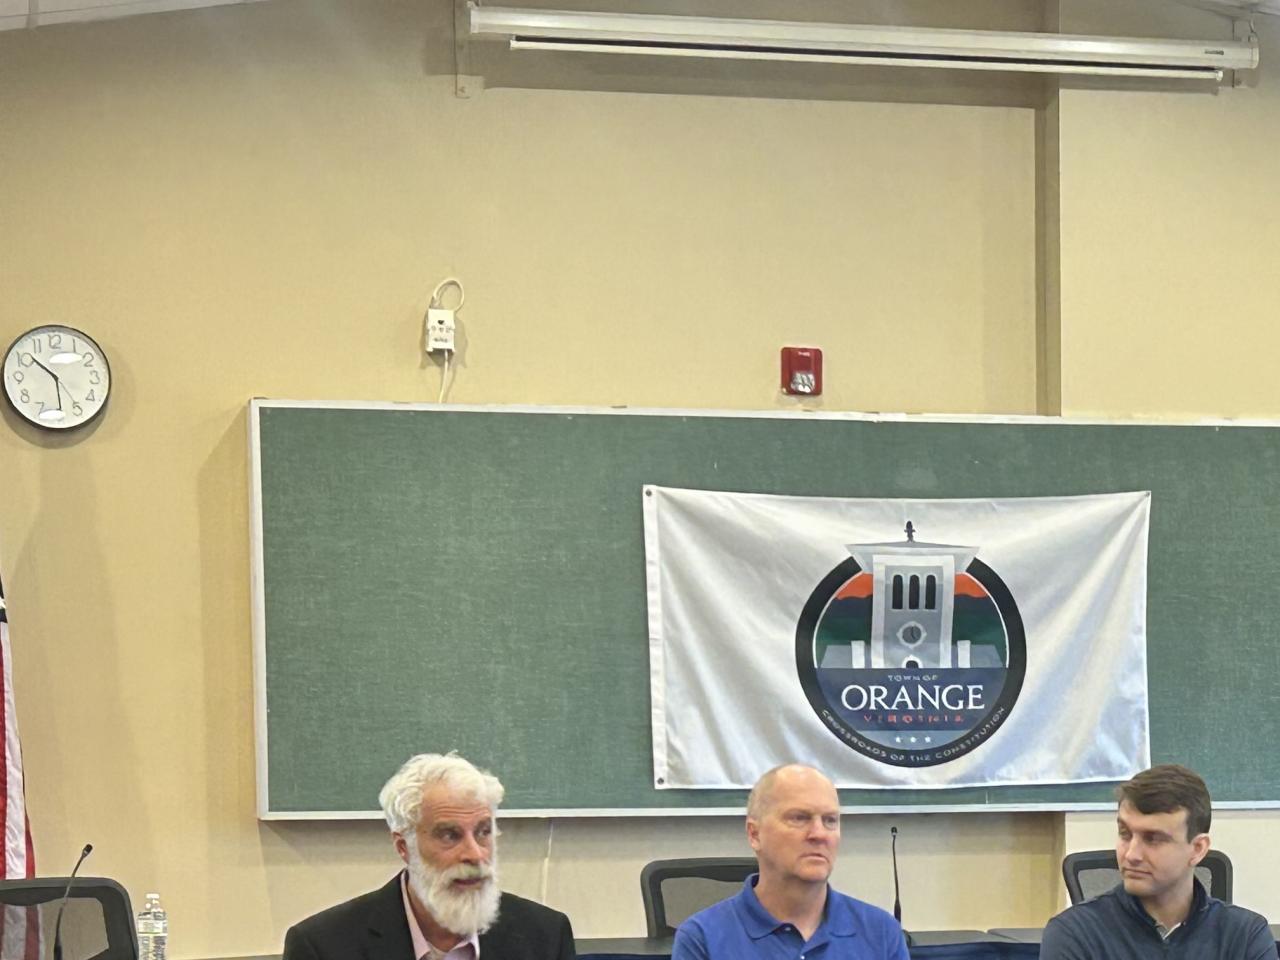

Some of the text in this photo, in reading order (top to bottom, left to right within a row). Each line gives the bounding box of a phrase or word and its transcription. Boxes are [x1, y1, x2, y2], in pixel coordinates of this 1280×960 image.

[33, 339, 42, 354] 11
[48, 334, 61, 349] 12
[72, 338, 76, 353] 1
[16, 350, 35, 368] 10
[82, 352, 94, 367] 2
[13, 371, 24, 384] 9
[89, 370, 100, 384] 3
[20, 389, 30, 403] 8
[85, 388, 96, 402] 4
[34, 401, 45, 416] 7
[72, 401, 84, 417] 5
[841, 684, 985, 710] ORANGE
[863, 714, 964, 723] VIRGINIA
